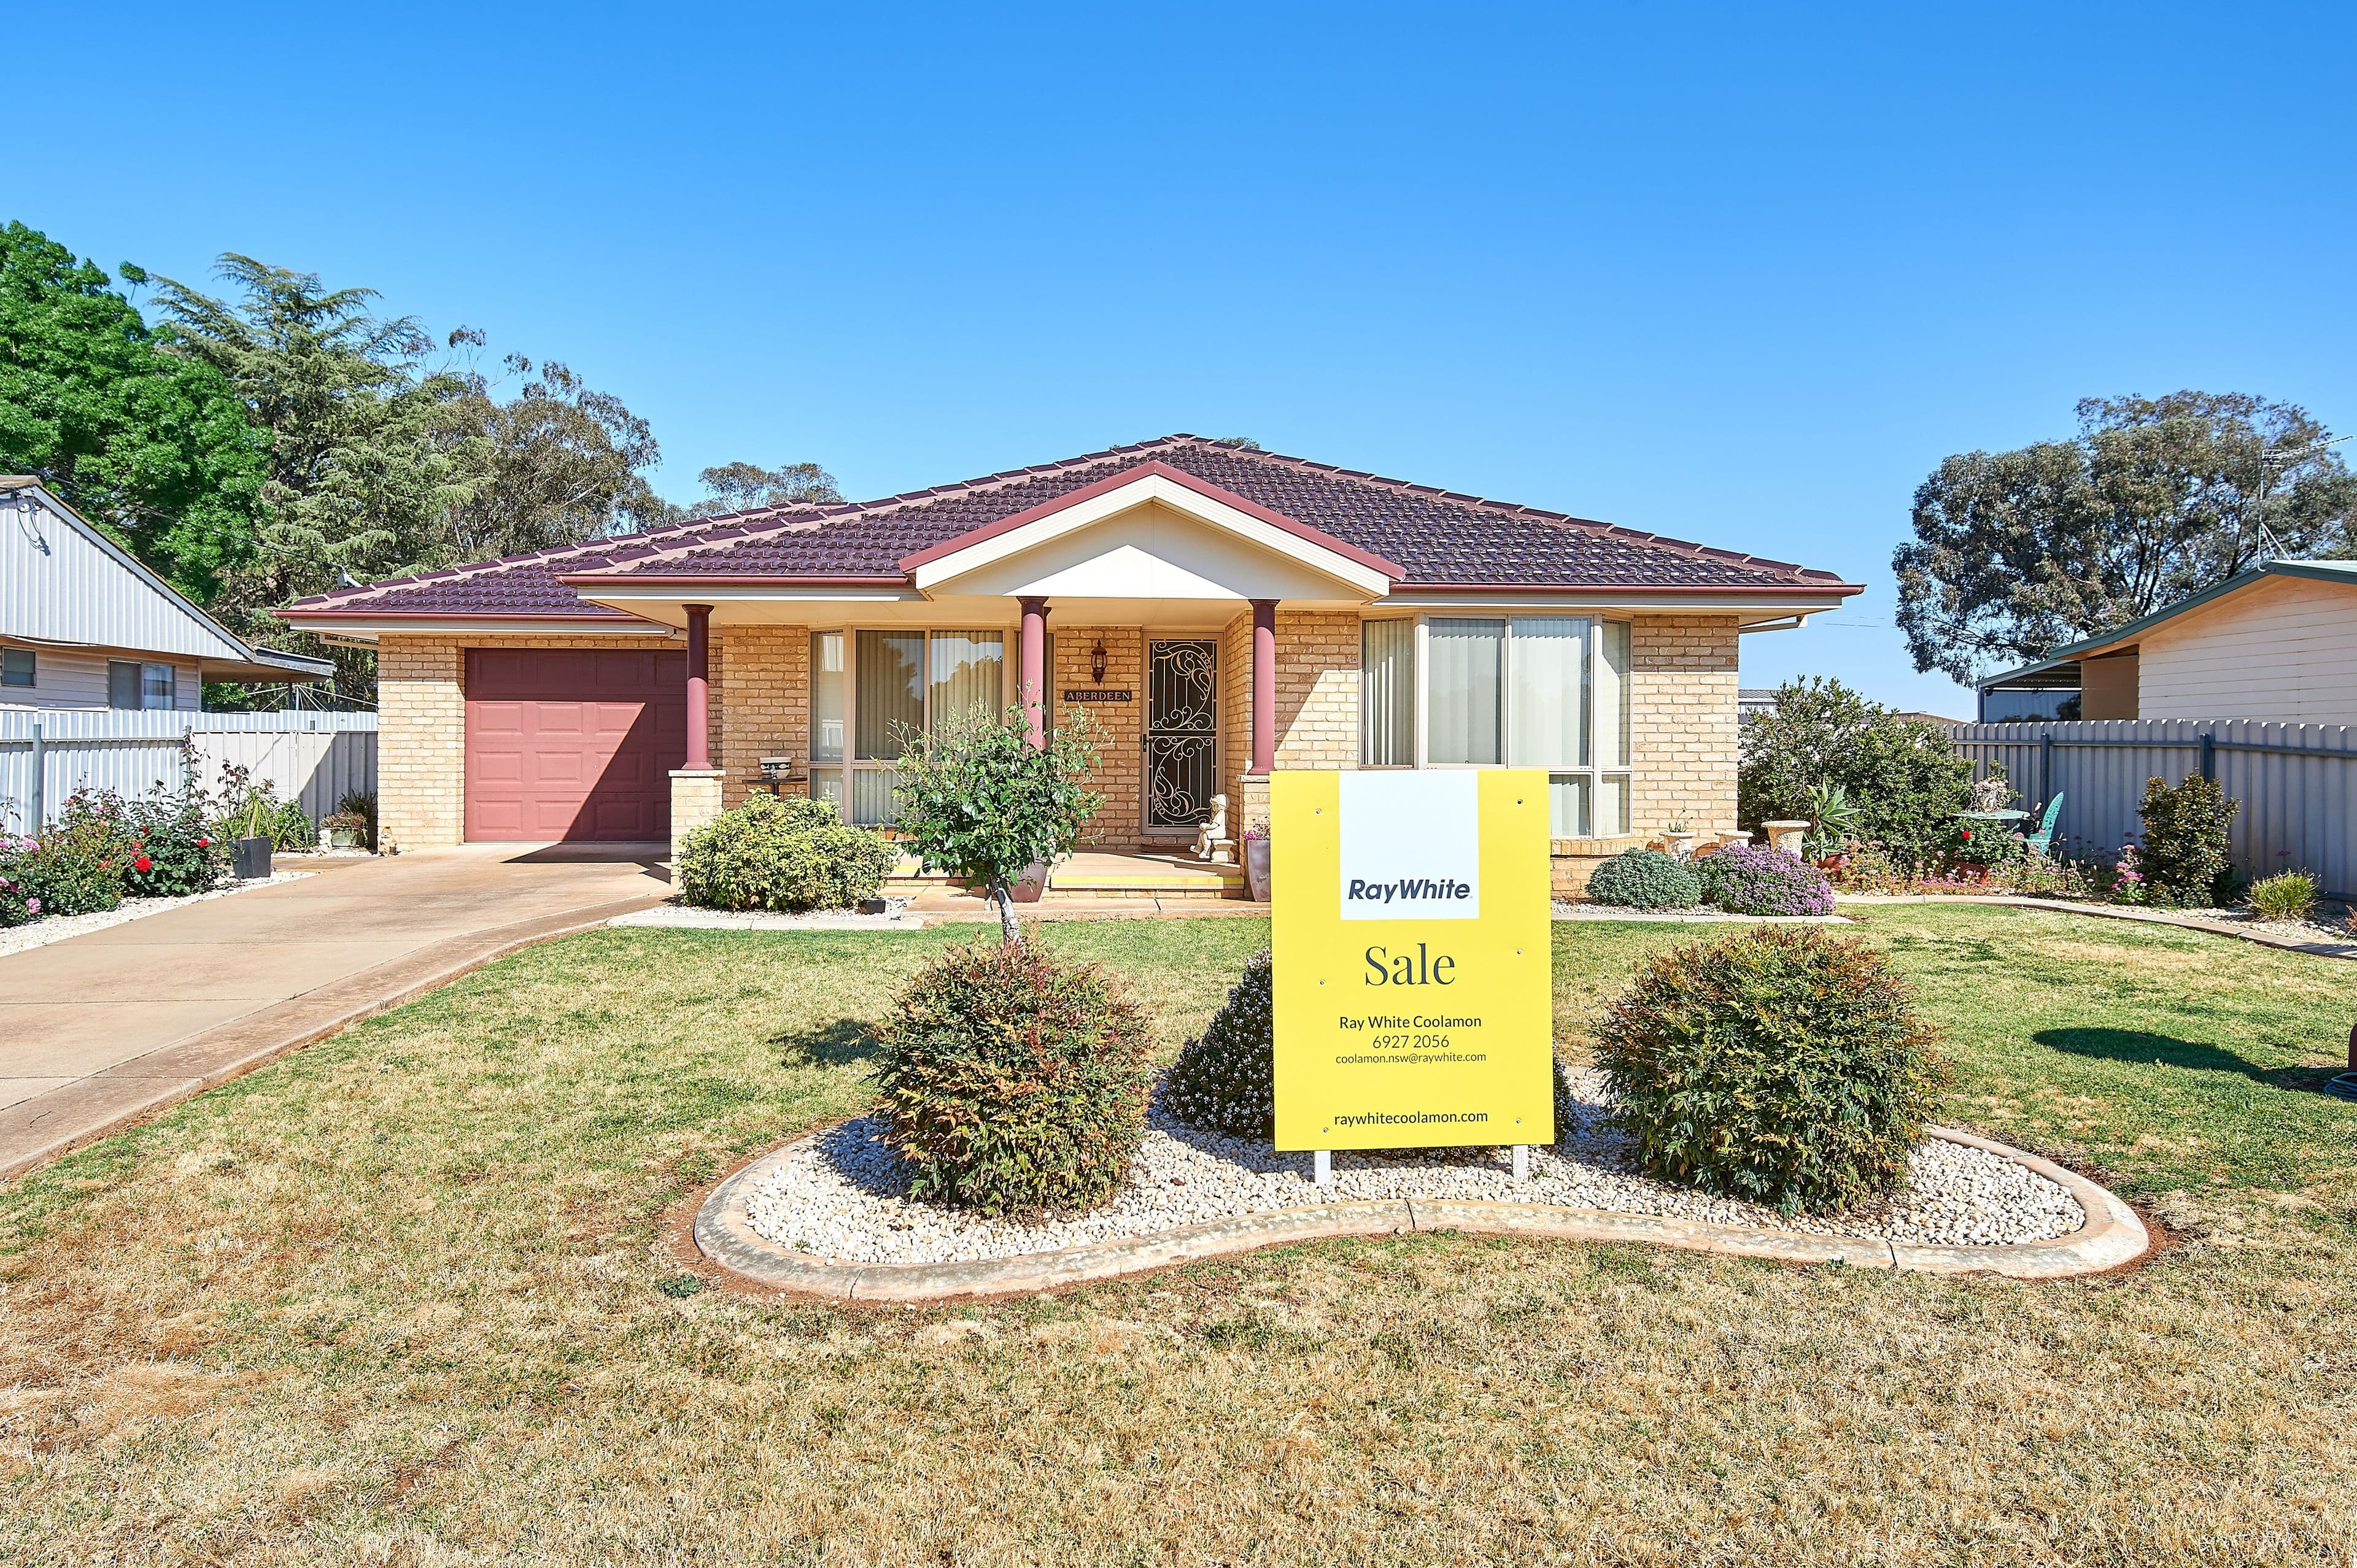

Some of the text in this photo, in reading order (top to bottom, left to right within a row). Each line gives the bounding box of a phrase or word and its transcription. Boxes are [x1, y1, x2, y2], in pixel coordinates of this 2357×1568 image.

[1067, 692, 1129, 700] ABERDEEN
[1365, 942, 1456, 987] Sale
[1339, 1014, 1482, 1031] Ray White Coolamon
[1372, 1034, 1450, 1049] 6927 2056
[1336, 1052, 1487, 1065] coolamon.nsw@raywhite.com
[1334, 1111, 1488, 1128] raywhitecoolamon.com
